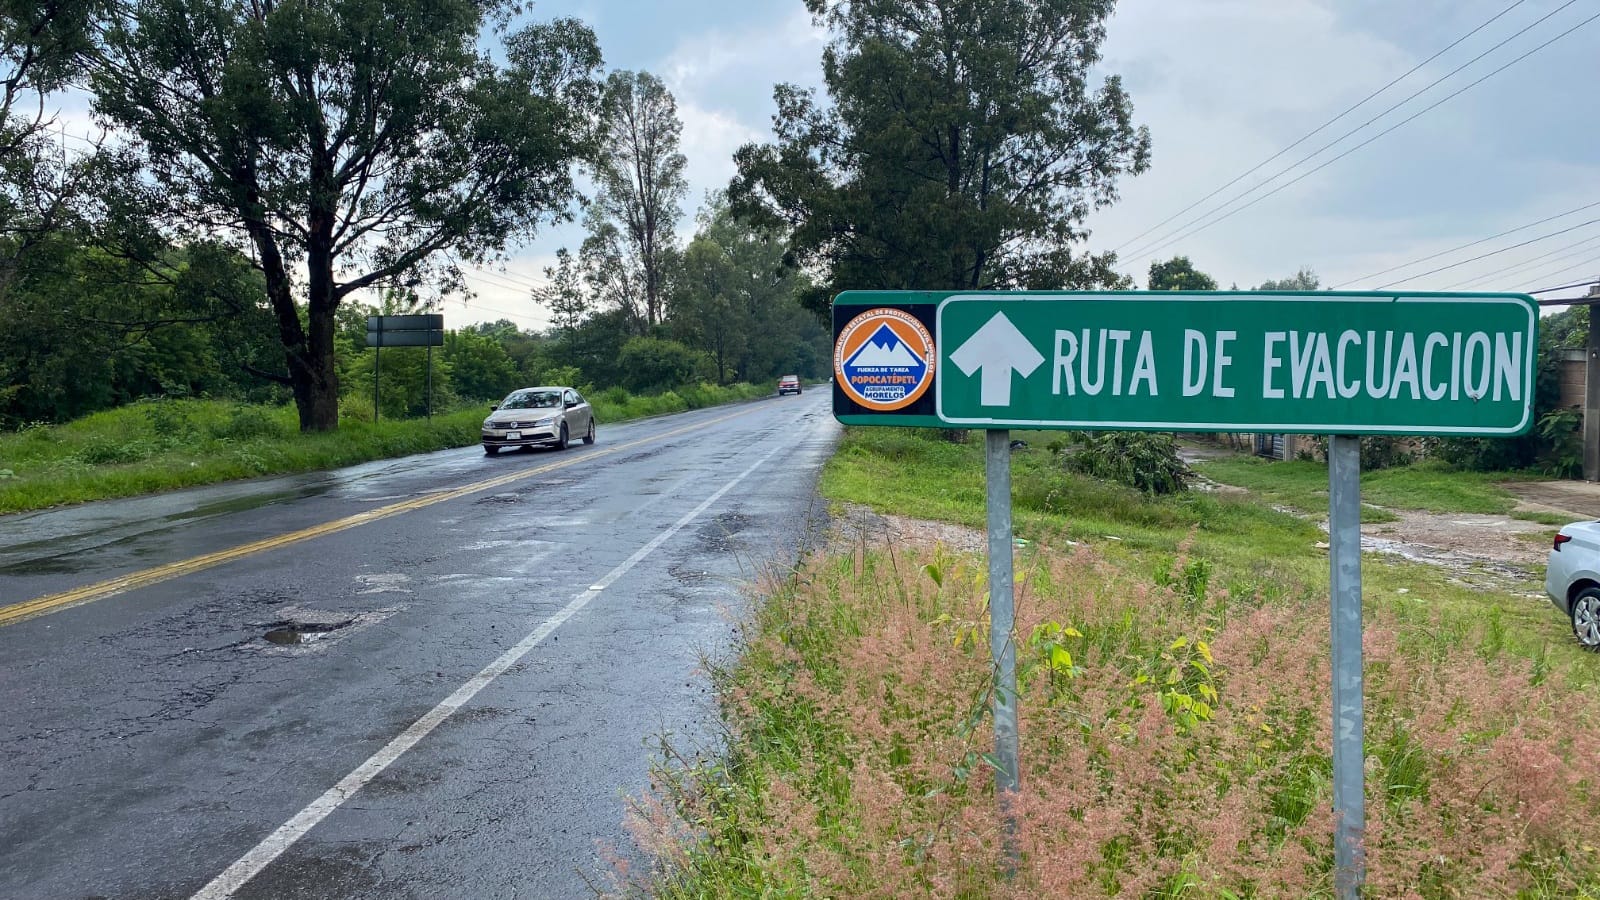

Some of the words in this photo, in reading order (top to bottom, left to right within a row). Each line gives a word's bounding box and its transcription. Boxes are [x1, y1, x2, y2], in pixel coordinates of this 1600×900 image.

[849, 311, 874, 328] ESTATAL
[1051, 328, 1159, 397] RUTA
[1182, 328, 1237, 399] DE
[1262, 329, 1522, 402] EVACUACION
[851, 373, 917, 385] POPOCATÉPETL
